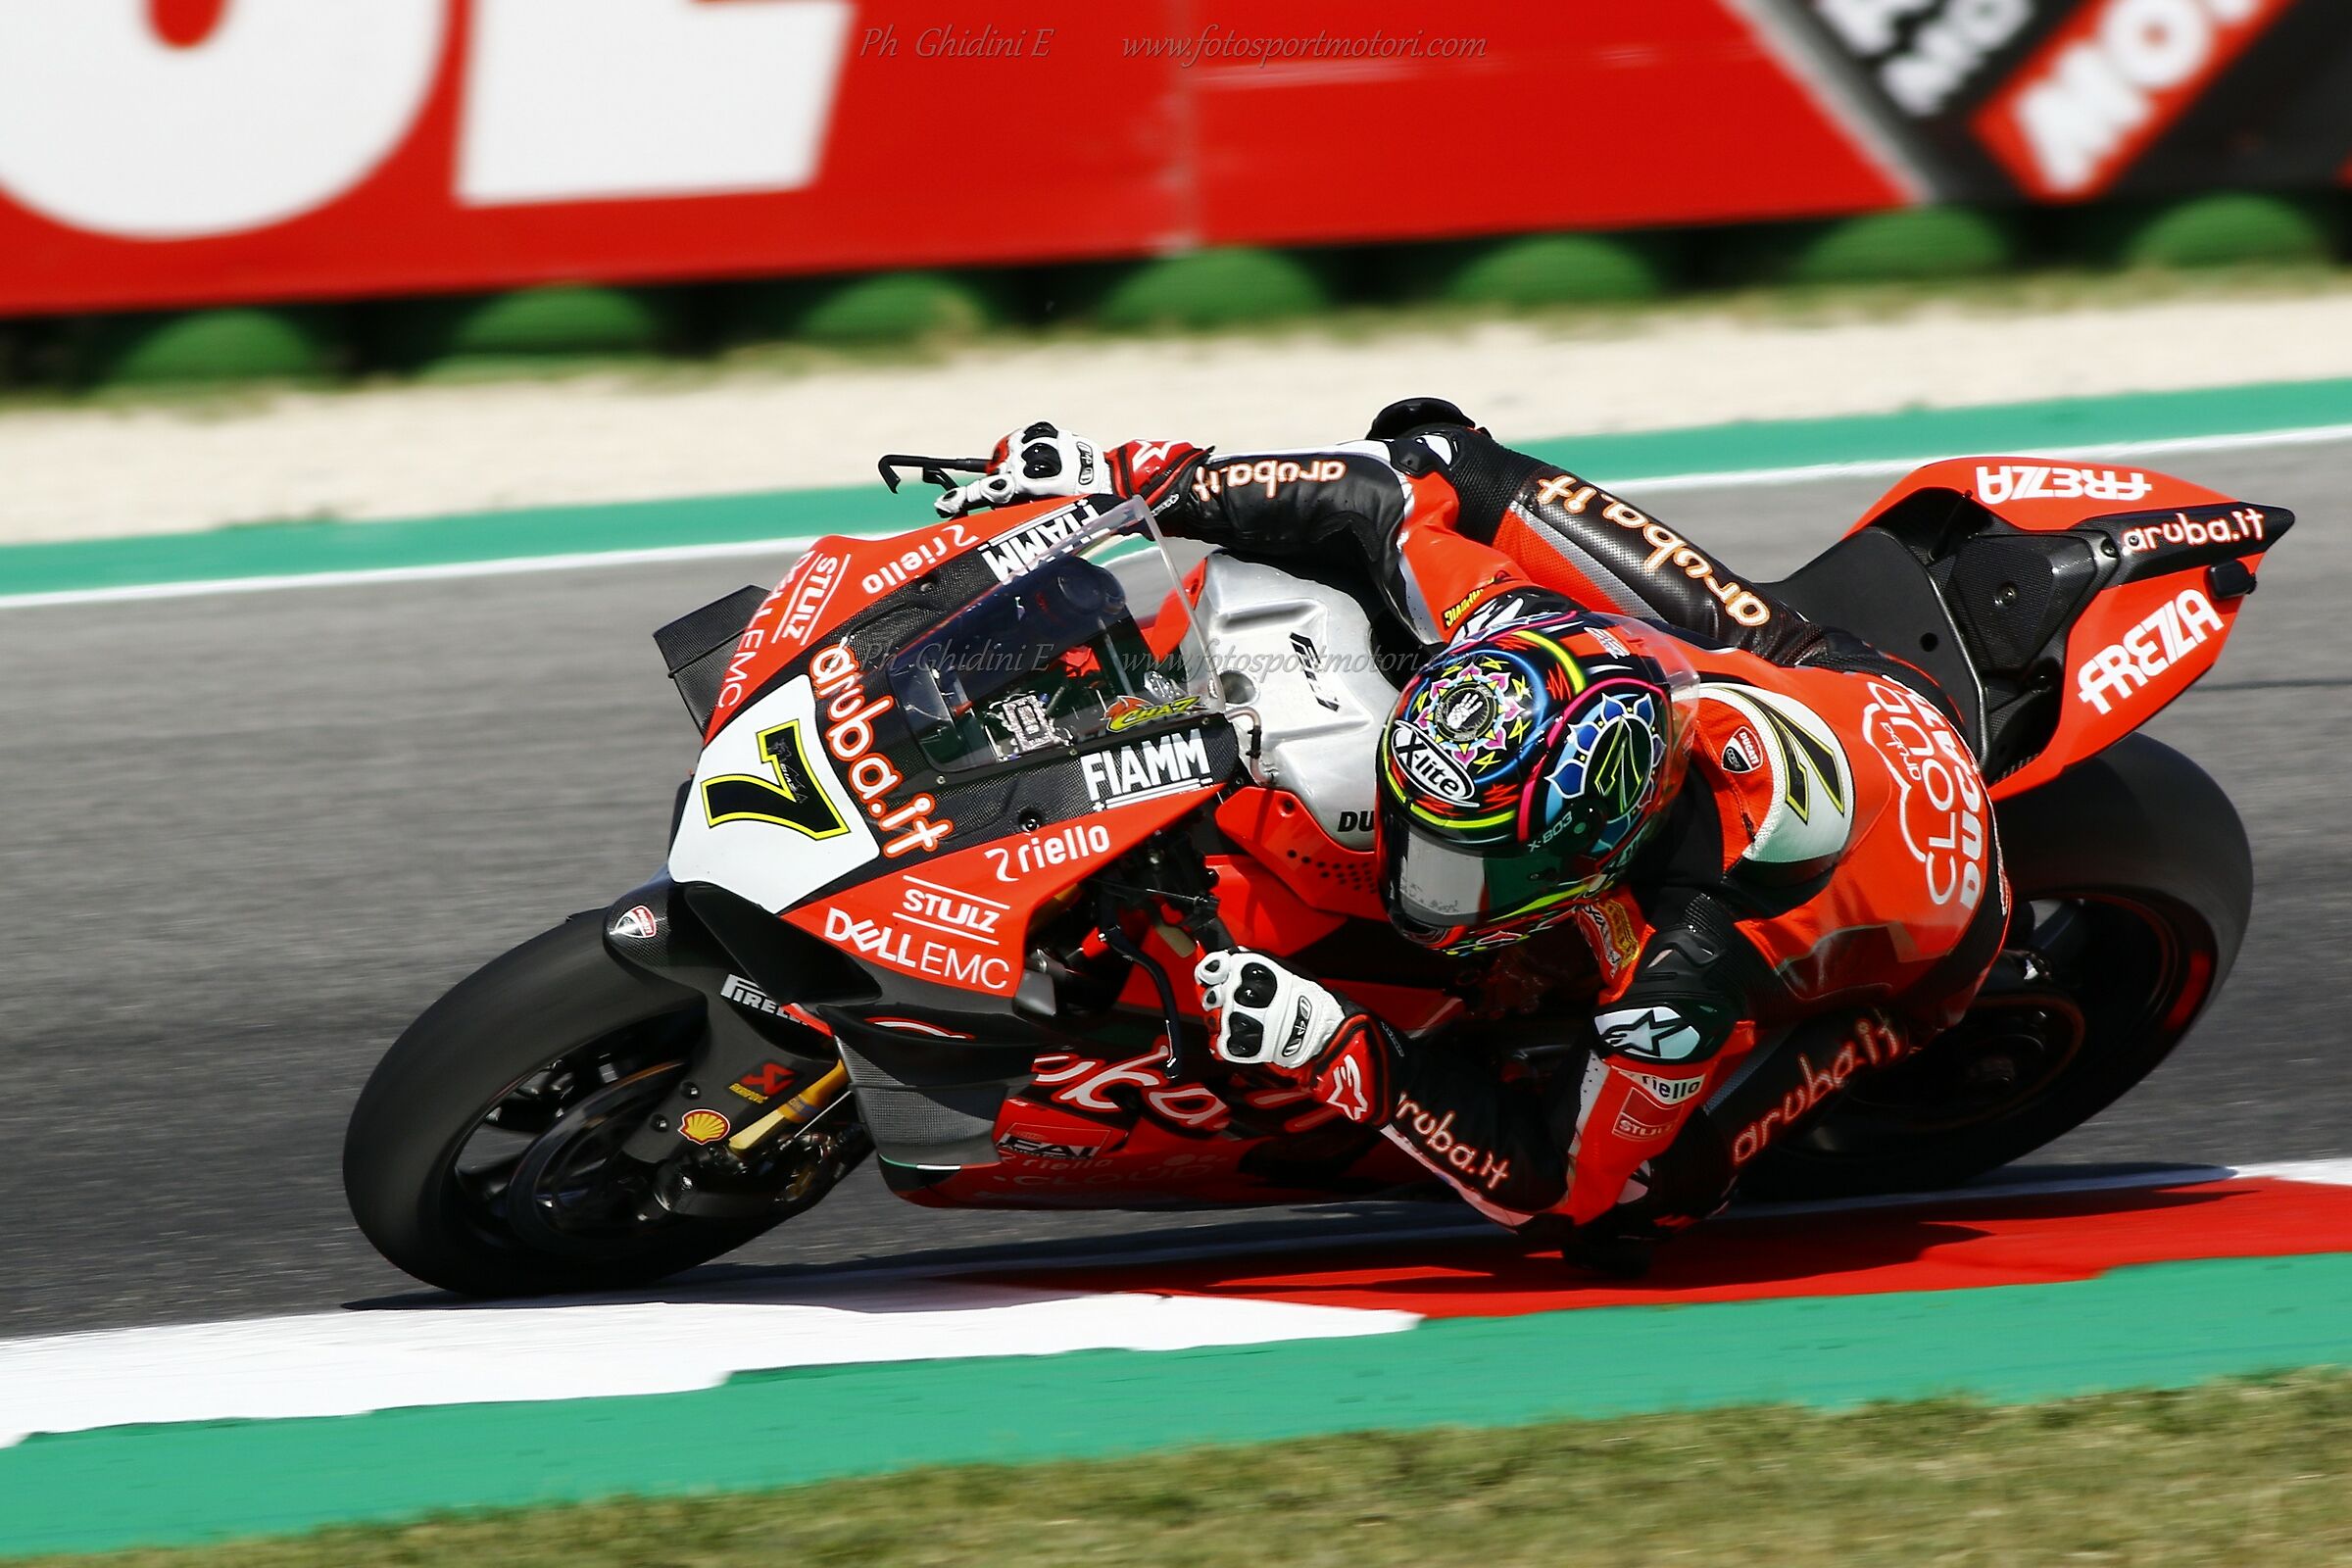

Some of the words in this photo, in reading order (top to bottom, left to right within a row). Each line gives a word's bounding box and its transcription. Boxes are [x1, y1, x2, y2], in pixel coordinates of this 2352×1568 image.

[1192, 459, 1349, 504] aruba.it
[1535, 473, 1772, 628] aruba.it
[2121, 506, 2267, 555] aruba.it
[861, 538, 959, 595] riello
[782, 556, 838, 639] STULZ
[810, 642, 952, 858] aruba.it
[1080, 728, 1210, 802] FIAMM
[1395, 729, 1460, 796] X-lite
[1739, 731, 1760, 764] DUCATI
[700, 718, 852, 841] 7
[1015, 824, 1110, 871] riello
[902, 888, 1001, 934] STULZ
[720, 973, 808, 1026] PIREL
